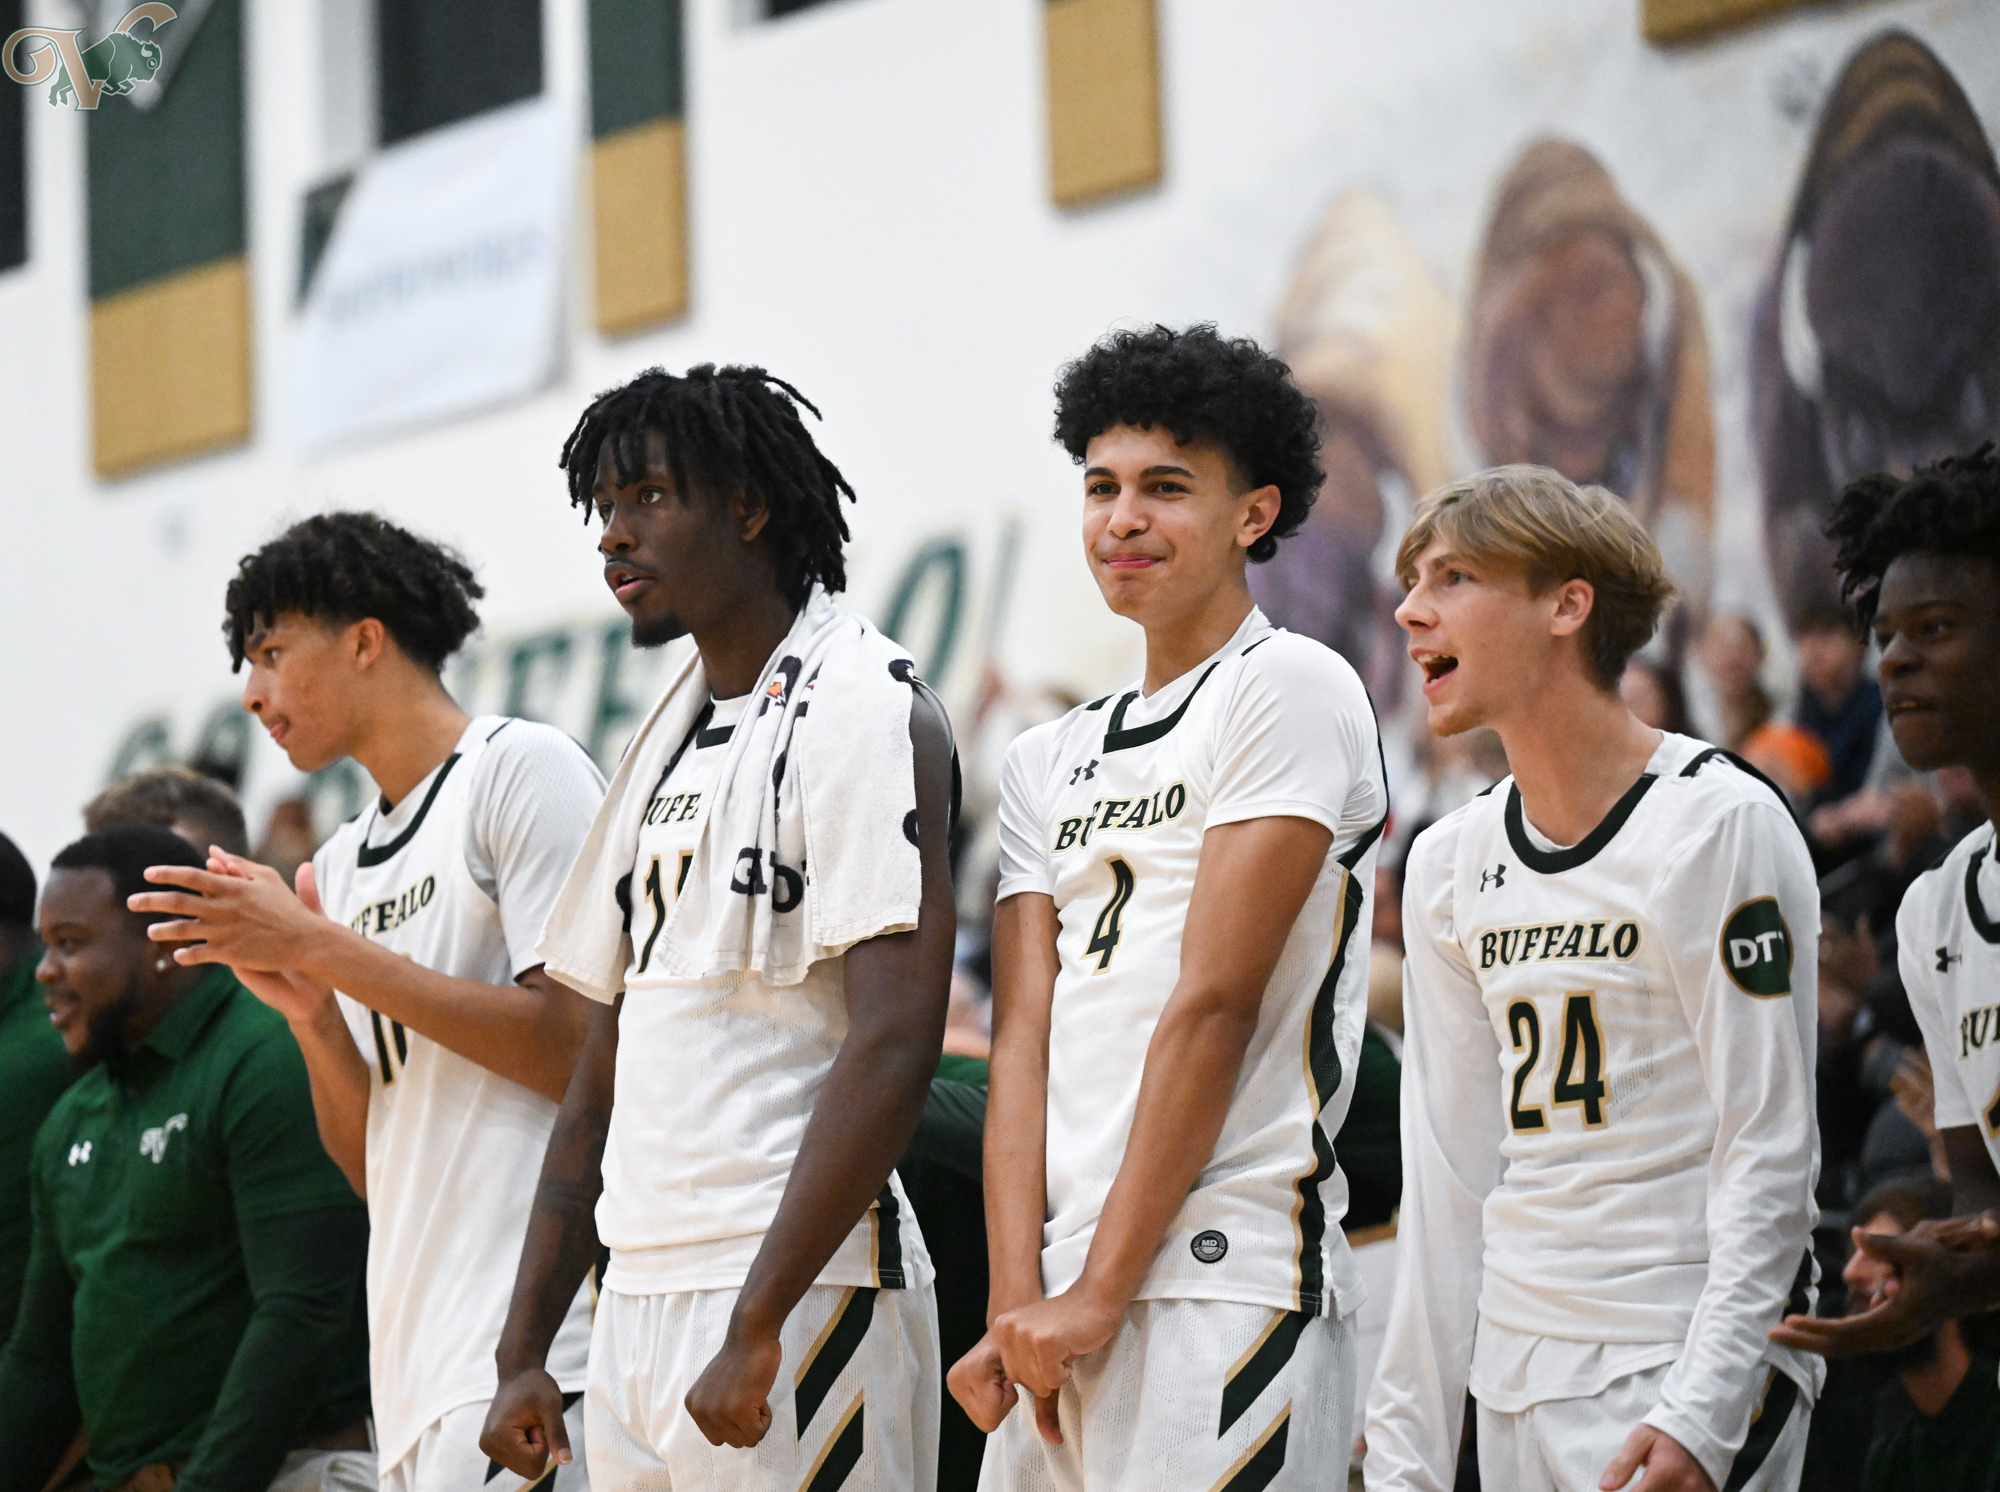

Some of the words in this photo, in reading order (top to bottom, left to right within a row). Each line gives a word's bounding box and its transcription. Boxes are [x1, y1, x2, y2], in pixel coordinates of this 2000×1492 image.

[645, 791, 703, 827] UFF
[1086, 858, 1134, 971] 4
[1480, 922, 1639, 969] BUFFALO
[1729, 932, 1784, 969] DT
[1508, 994, 1606, 1130] 24
[1201, 1239, 1218, 1247] MD
